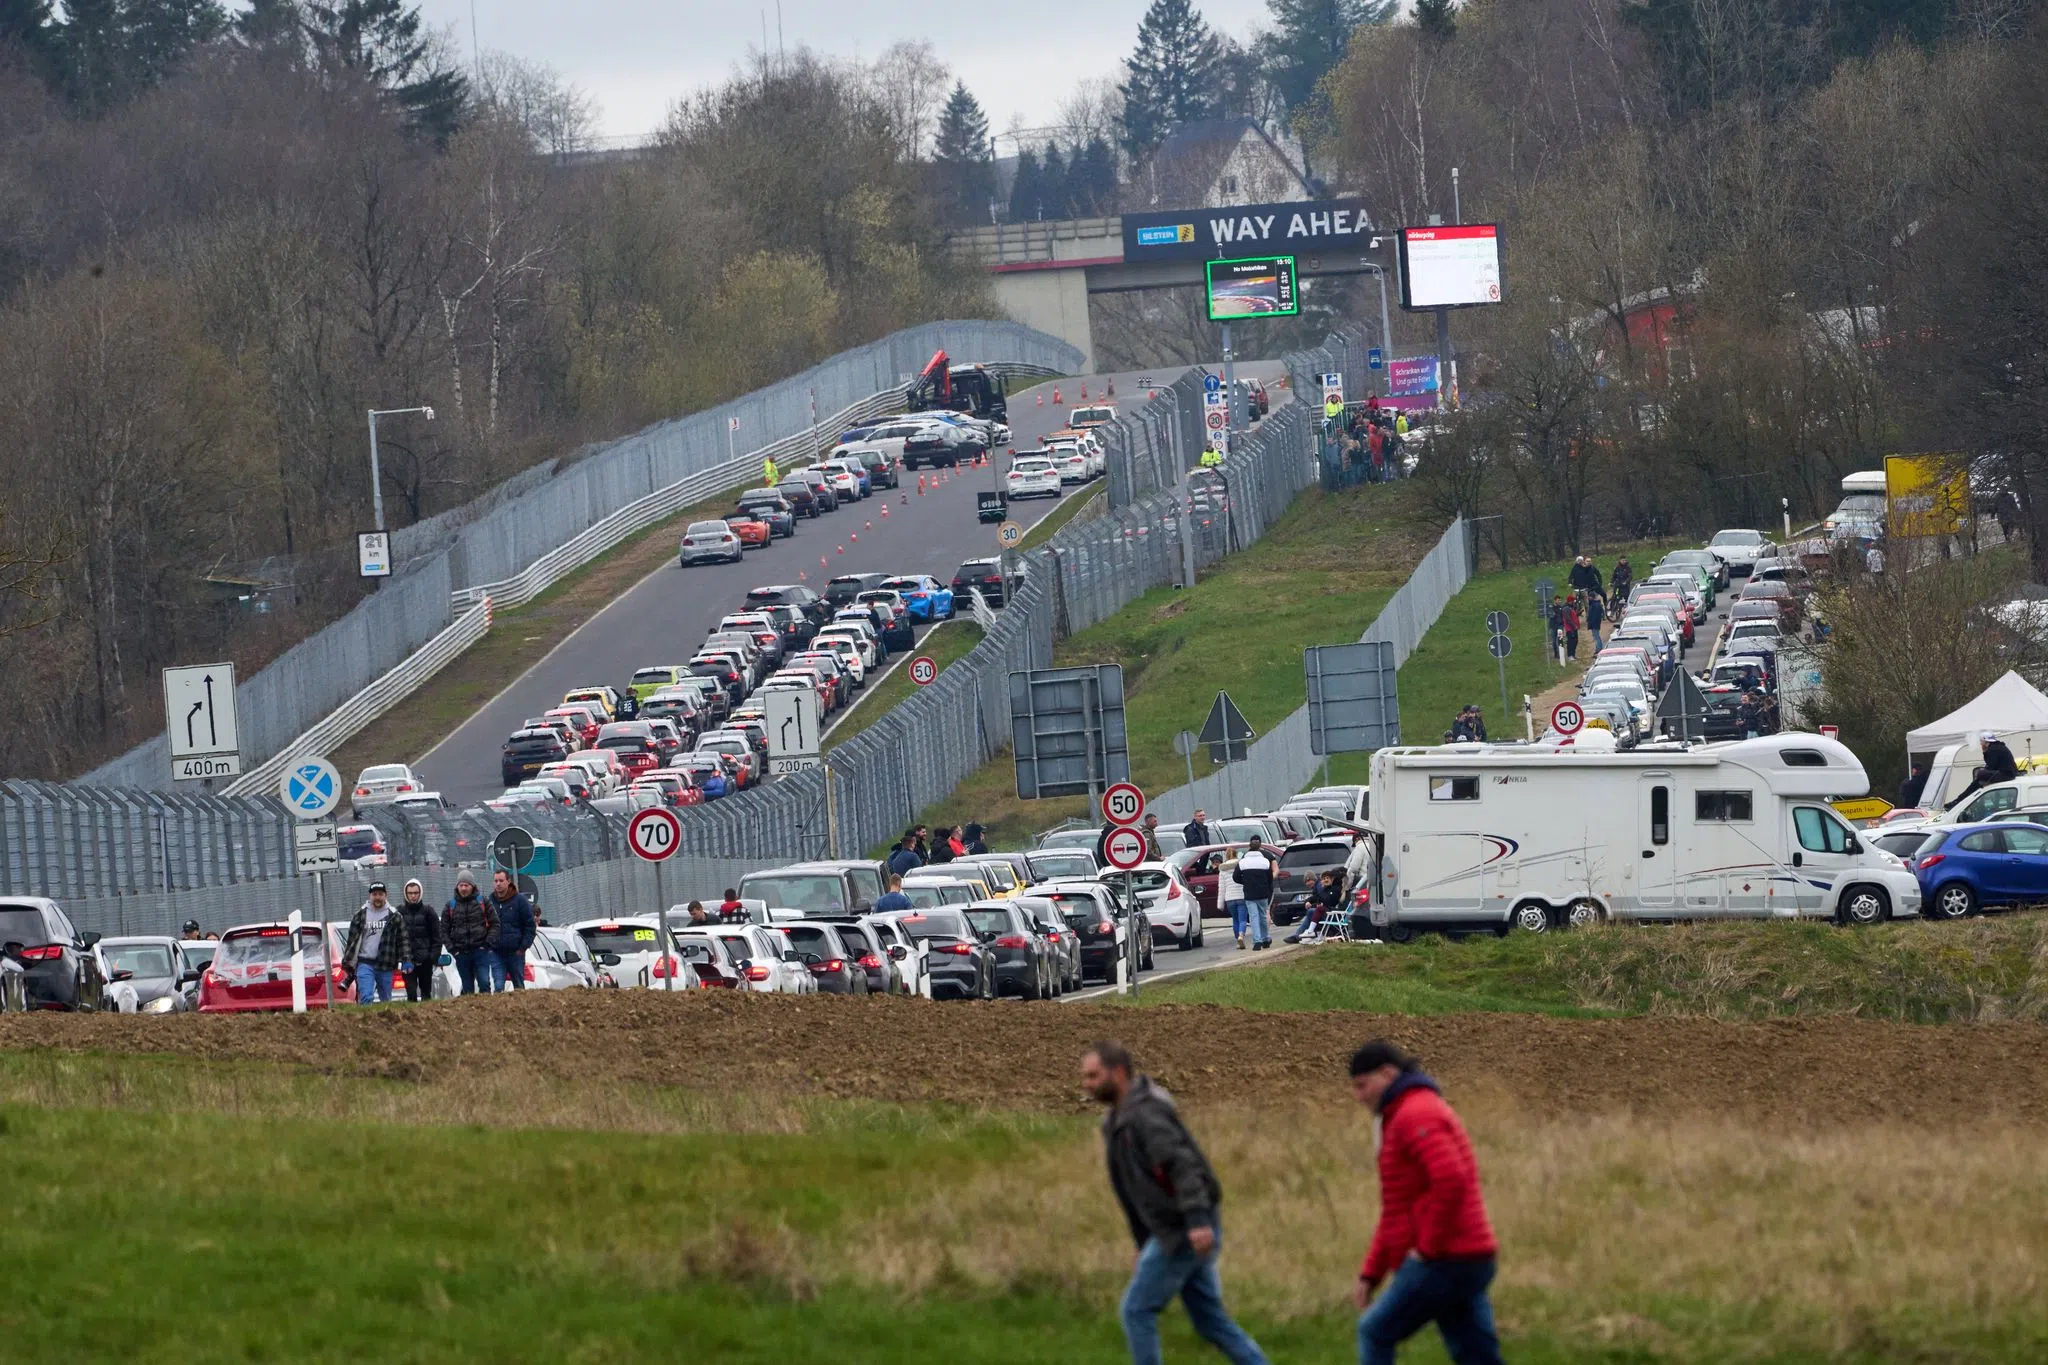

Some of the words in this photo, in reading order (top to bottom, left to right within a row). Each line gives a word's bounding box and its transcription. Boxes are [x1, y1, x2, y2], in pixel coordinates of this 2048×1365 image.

[1210, 214, 1275, 243] WAY
[1287, 208, 1377, 238] AHEA
[1396, 378, 1406, 386] Und
[1210, 416, 1220, 425] 30
[1003, 527, 1017, 541] 30
[365, 535, 382, 549] 21
[915, 665, 932, 678] 50
[1558, 710, 1578, 727] 50
[1493, 774, 1528, 785] FRANKIA
[1112, 795, 1136, 814] 50
[1836, 806, 1863, 815] euspath
[640, 823, 670, 847] 70
